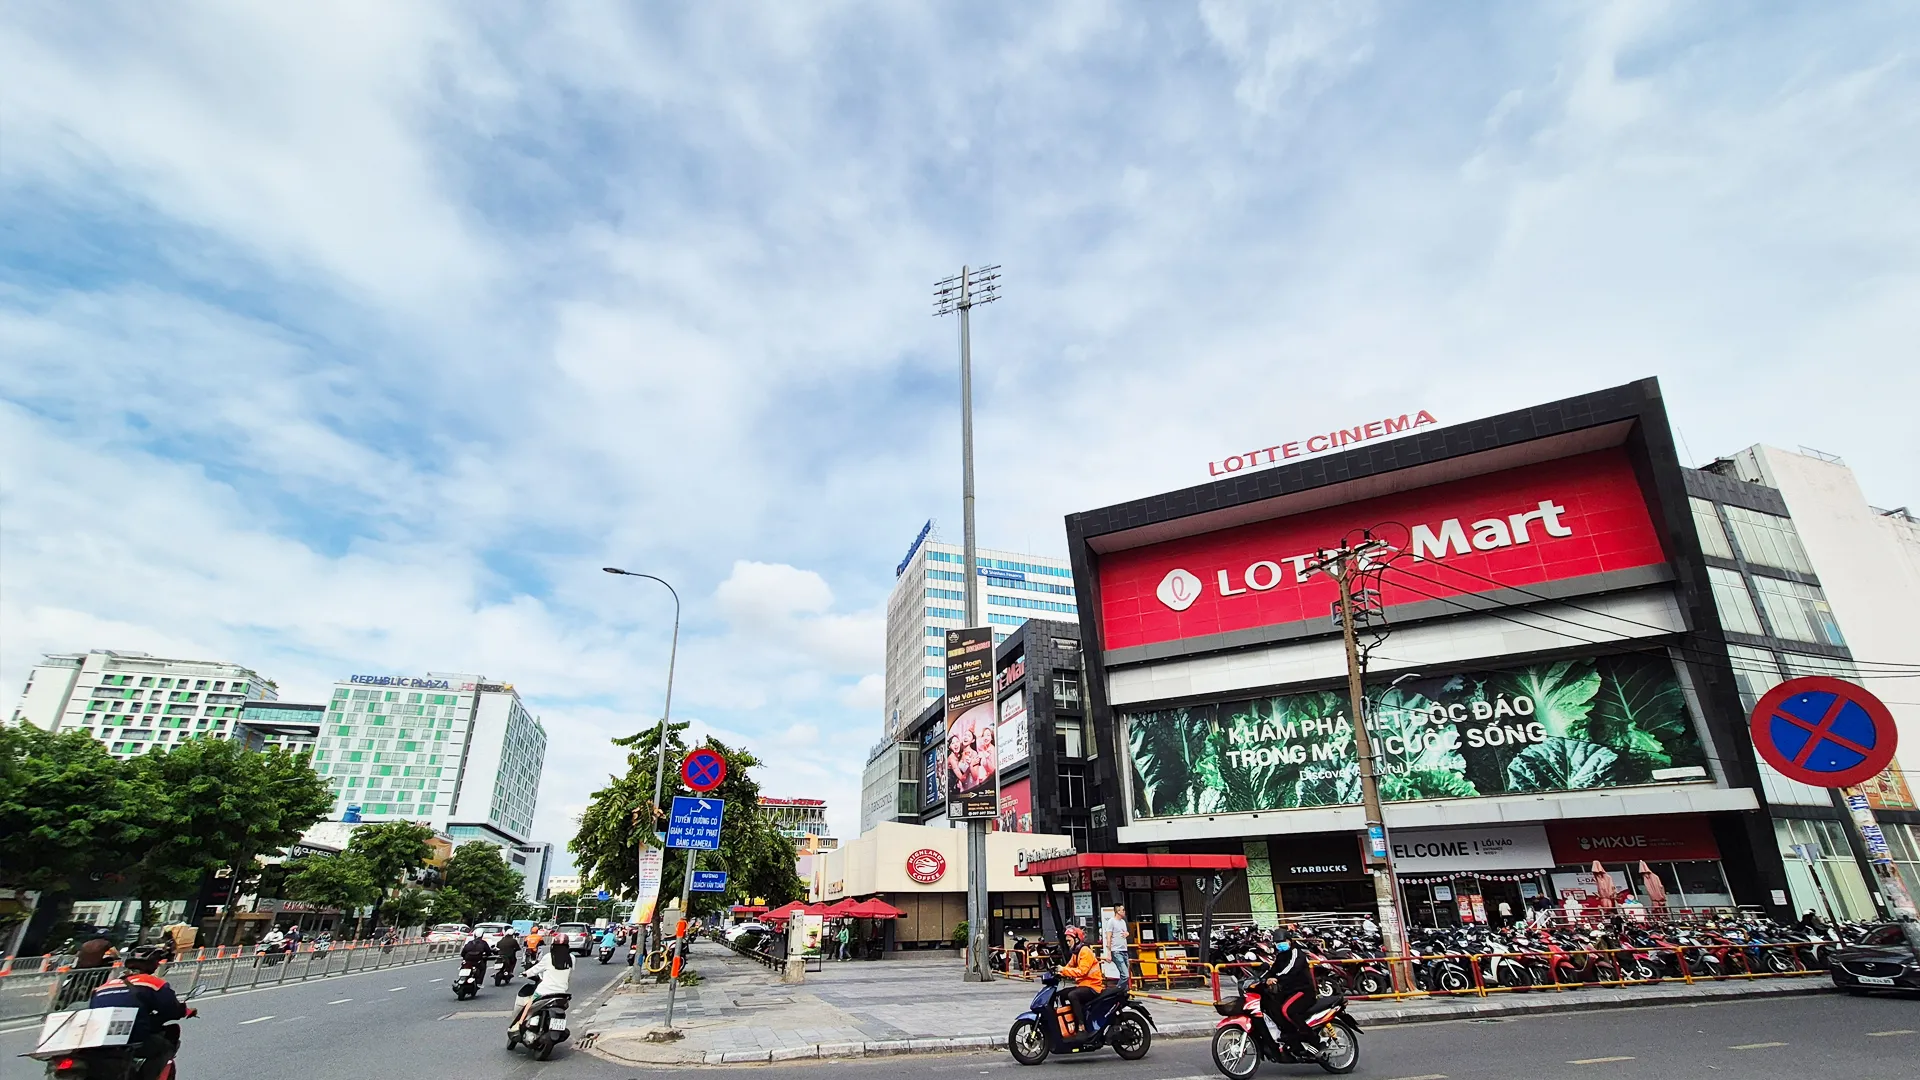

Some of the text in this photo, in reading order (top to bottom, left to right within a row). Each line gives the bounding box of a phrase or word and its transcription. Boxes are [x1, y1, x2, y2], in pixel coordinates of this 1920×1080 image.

[1208, 409, 1438, 477] LOTTE CINEMA
[1411, 499, 1572, 563] Mart
[350, 674, 410, 687] REPUBLIC
[410, 678, 449, 689] PLAZA
[1228, 717, 1298, 745] KHÁM
[1301, 710, 1352, 738] PHÁ
[1471, 693, 1534, 721] ĐÁO
[1226, 744, 1306, 769] TRONG
[1467, 720, 1548, 749] SỐNG
[675, 813, 691, 824] TUYẾN
[711, 816, 718, 825] CÓ
[670, 825, 683, 835] GIÁM
[706, 829, 718, 837] PHẠT
[691, 839, 712, 847] CAMERA
[1495, 838, 1512, 846] VÀO
[1592, 835, 1647, 849] MIXUE
[909, 850, 945, 864] HIGHLANDS
[1390, 841, 1470, 859] ELCOME
[1290, 864, 1348, 874] STARBUCKS
[912, 872, 940, 881] COFFEE
